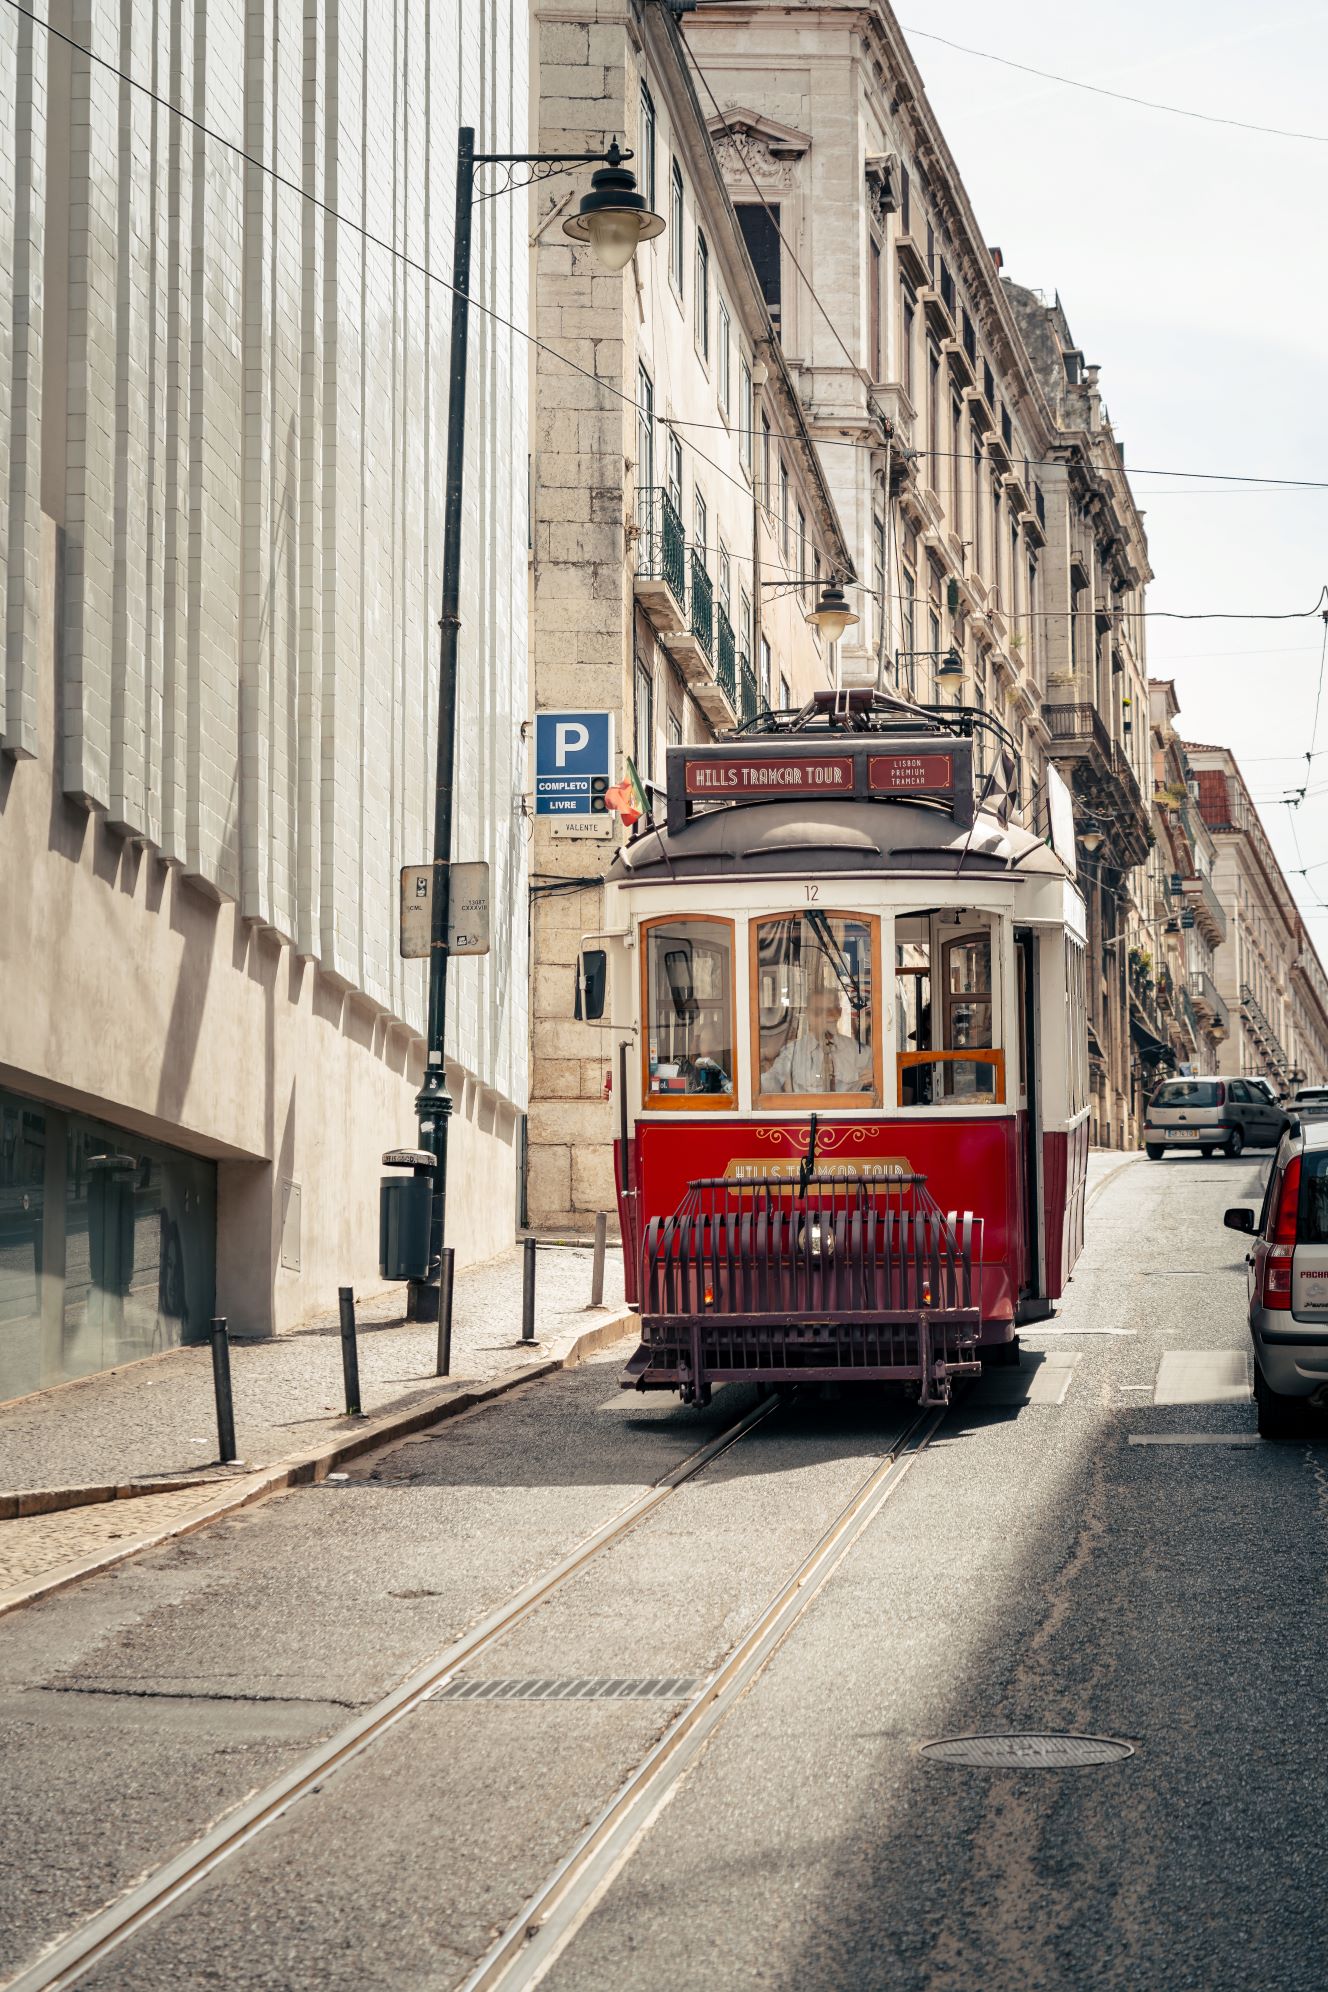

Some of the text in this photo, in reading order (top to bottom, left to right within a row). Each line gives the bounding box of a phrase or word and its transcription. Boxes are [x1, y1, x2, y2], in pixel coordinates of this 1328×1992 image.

[556, 722, 589, 767] P
[893, 760, 921, 768] LISBON
[695, 766, 843, 786] HILLS TRAMCAR TOUR
[891, 769, 925, 777] PREMIUM
[538, 781, 588, 791] COMPLETO
[891, 777, 925, 786] TRAMCAR
[549, 801, 577, 810] LIVRE
[565, 823, 599, 832] VALENTE
[804, 885, 820, 901] 12
